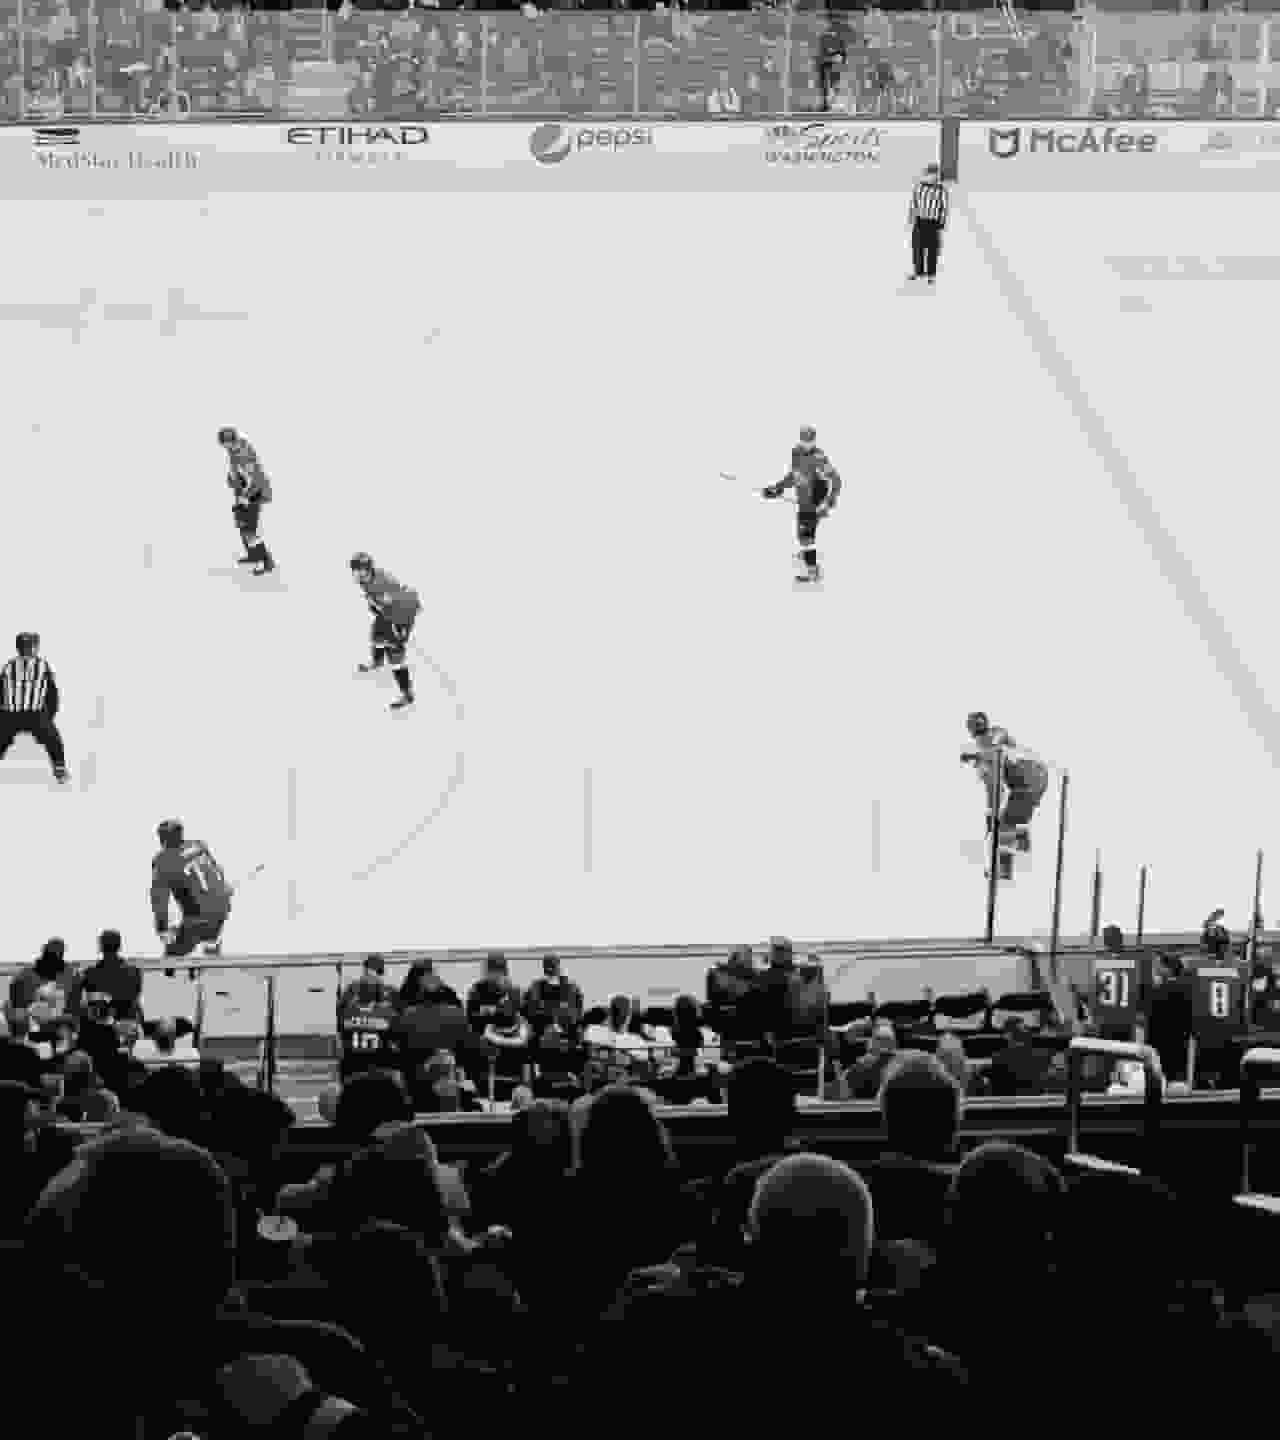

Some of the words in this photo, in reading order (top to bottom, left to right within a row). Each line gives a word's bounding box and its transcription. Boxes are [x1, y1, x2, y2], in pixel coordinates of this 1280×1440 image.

[287, 127, 433, 145] ETIHAD
[575, 126, 655, 153] pepsi
[1030, 127, 1159, 153] McAfee
[1099, 970, 1130, 1009] 31
